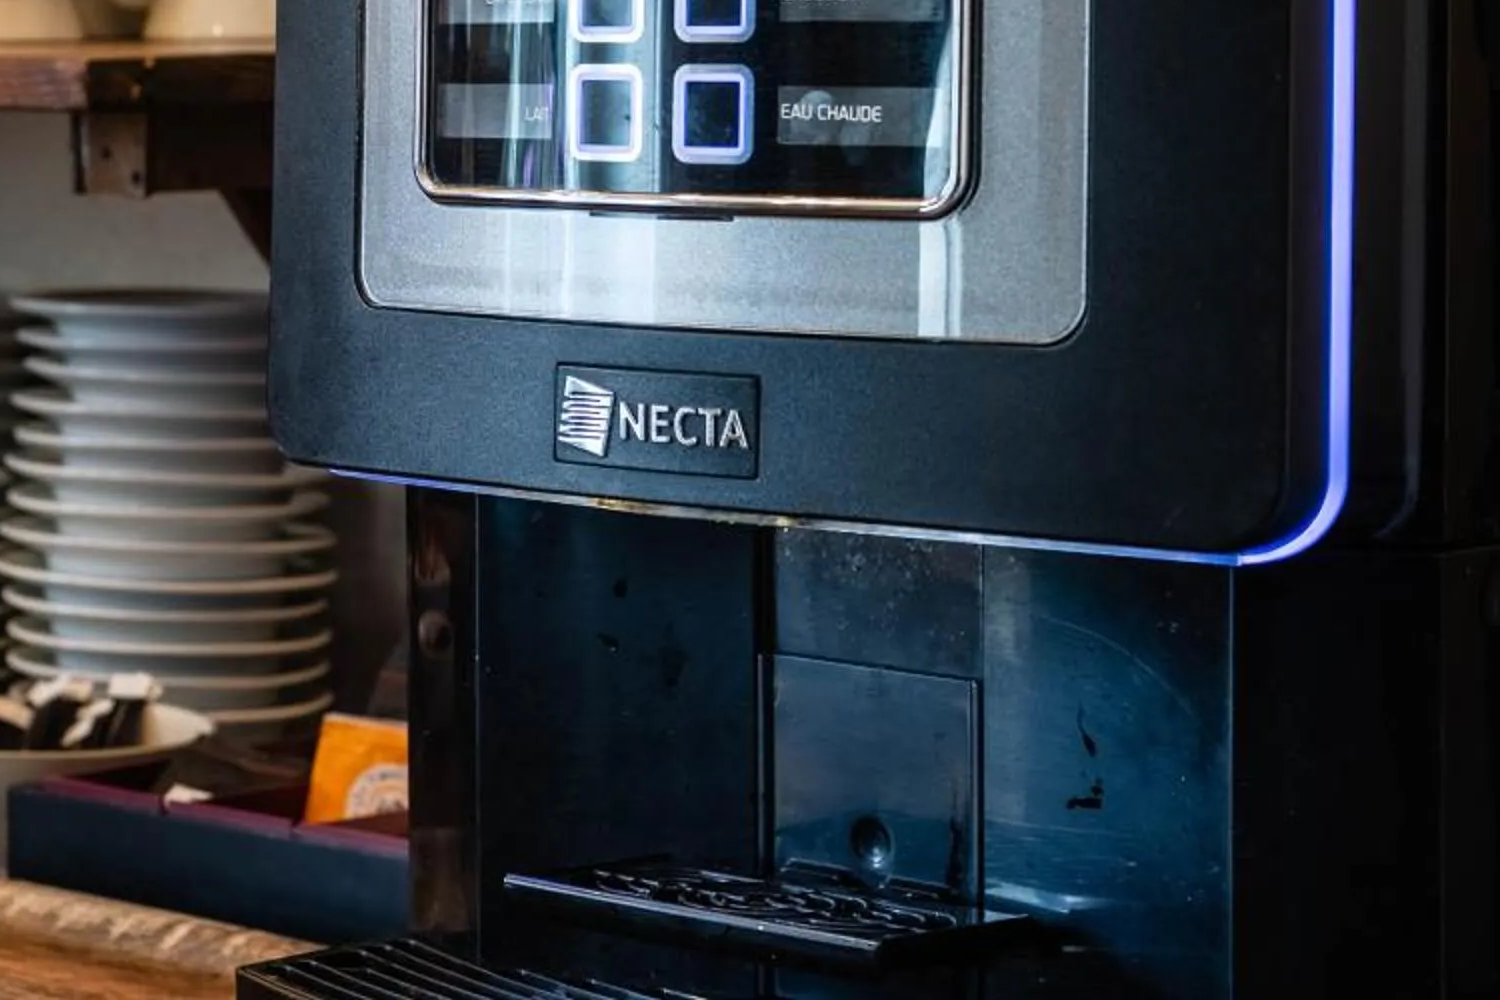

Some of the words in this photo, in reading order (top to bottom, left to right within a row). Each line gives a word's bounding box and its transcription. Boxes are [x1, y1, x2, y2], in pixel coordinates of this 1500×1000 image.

[780, 103, 813, 120] EAU
[816, 104, 883, 123] CHAUDE
[618, 401, 749, 449] NECTA
